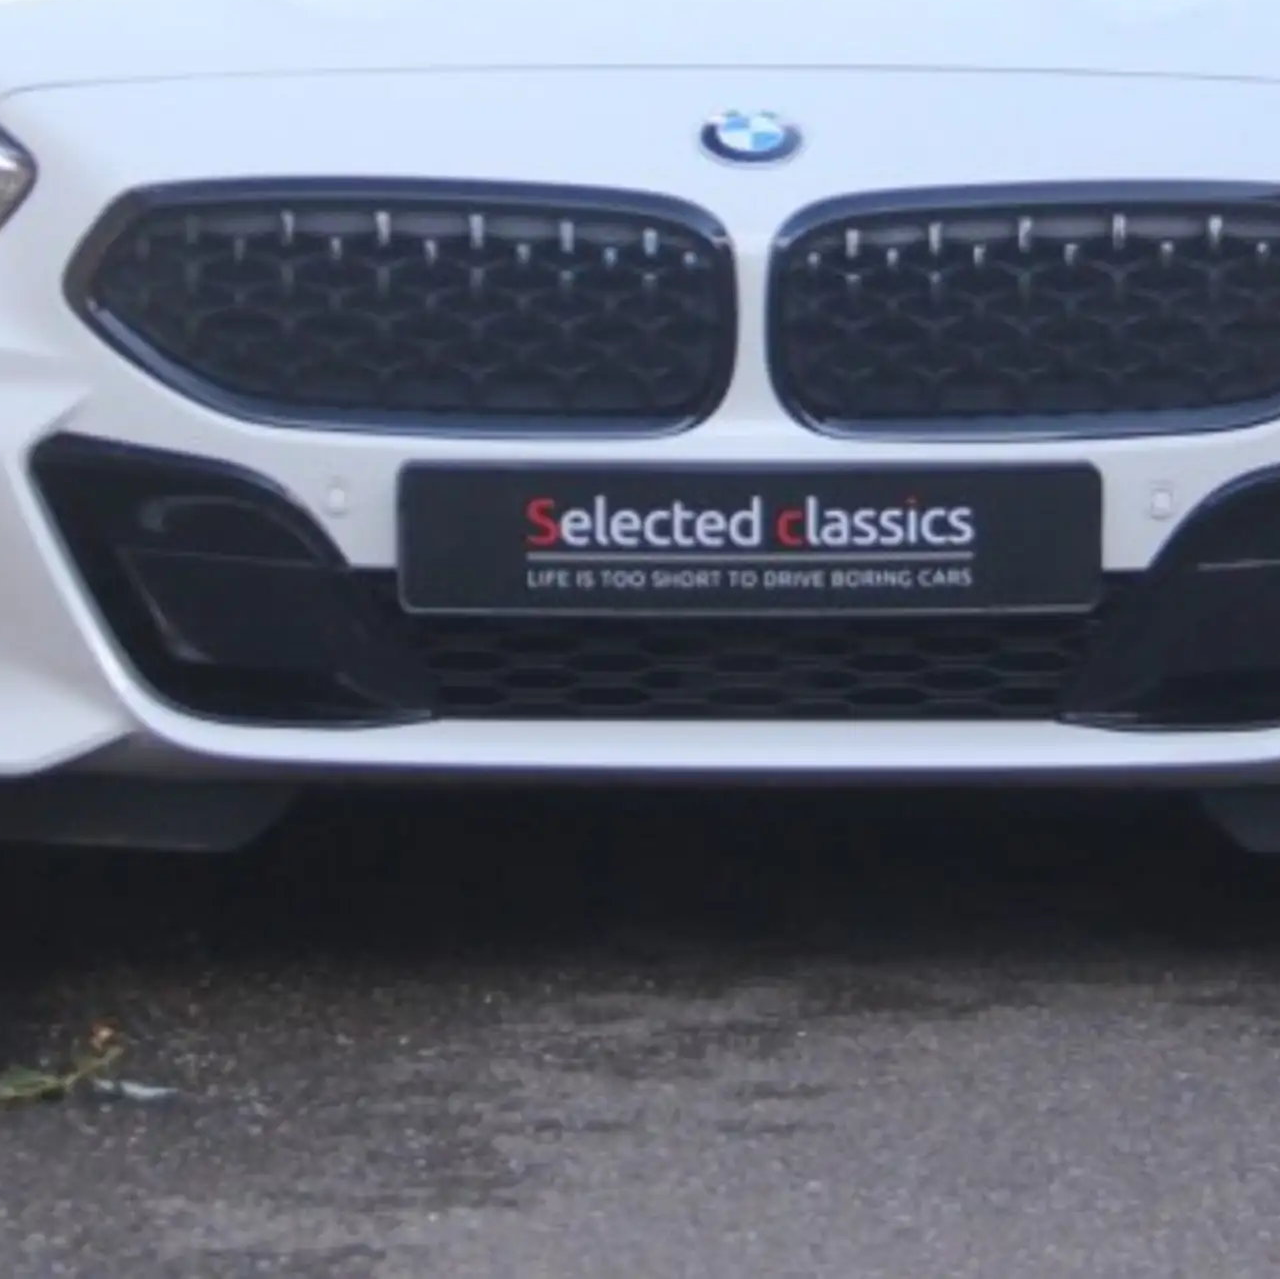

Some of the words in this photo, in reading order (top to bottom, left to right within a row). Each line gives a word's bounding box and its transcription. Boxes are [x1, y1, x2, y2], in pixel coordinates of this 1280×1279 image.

[526, 494, 761, 547] Selected
[777, 495, 974, 547] classics
[527, 571, 569, 588] LIFE
[575, 571, 595, 588] IS
[601, 571, 646, 589] TOO
[651, 571, 720, 589] SHORT
[728, 571, 757, 588] TO
[763, 570, 824, 588] DRIVE
[831, 569, 912, 588] BORING
[917, 568, 972, 587] CARS
